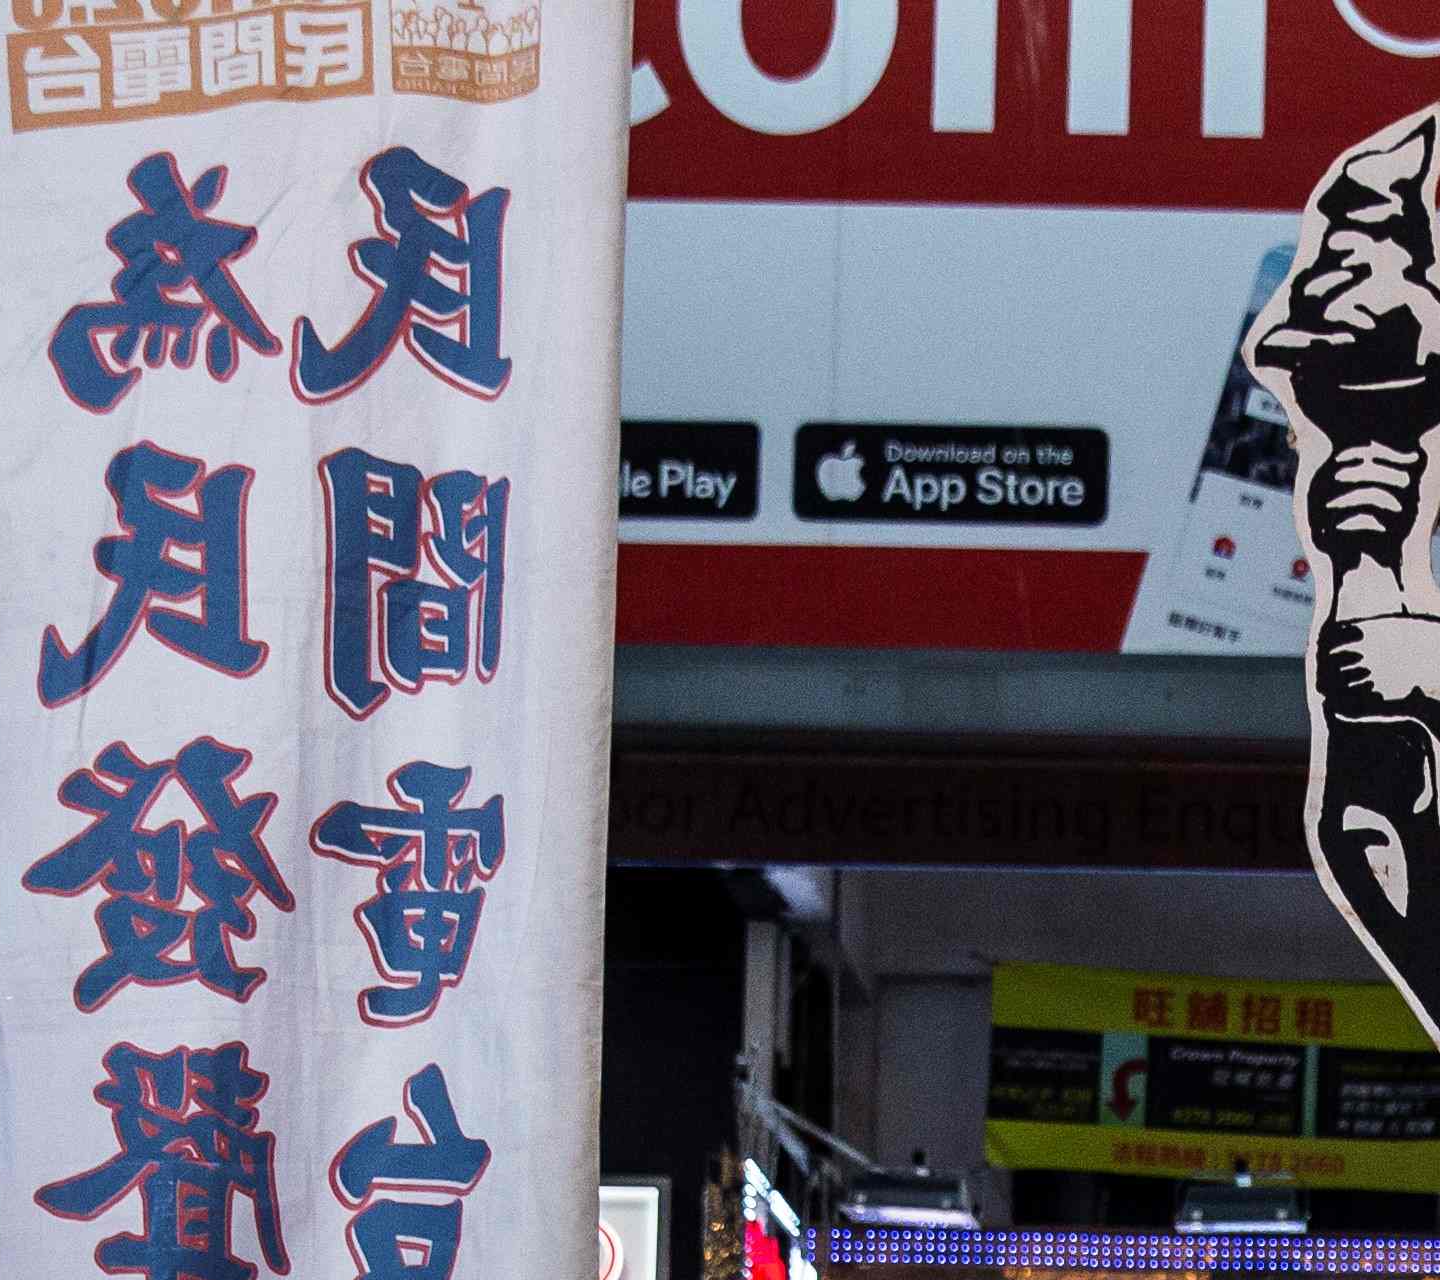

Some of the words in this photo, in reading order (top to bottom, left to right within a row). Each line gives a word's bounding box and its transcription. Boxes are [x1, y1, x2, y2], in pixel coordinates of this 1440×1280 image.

[885, 443, 997, 464] Download
[1003, 445, 1031, 464] on
[1036, 447, 1074, 466] the
[659, 460, 737, 510] Play
[882, 470, 967, 512] App
[974, 470, 1087, 506] Store
